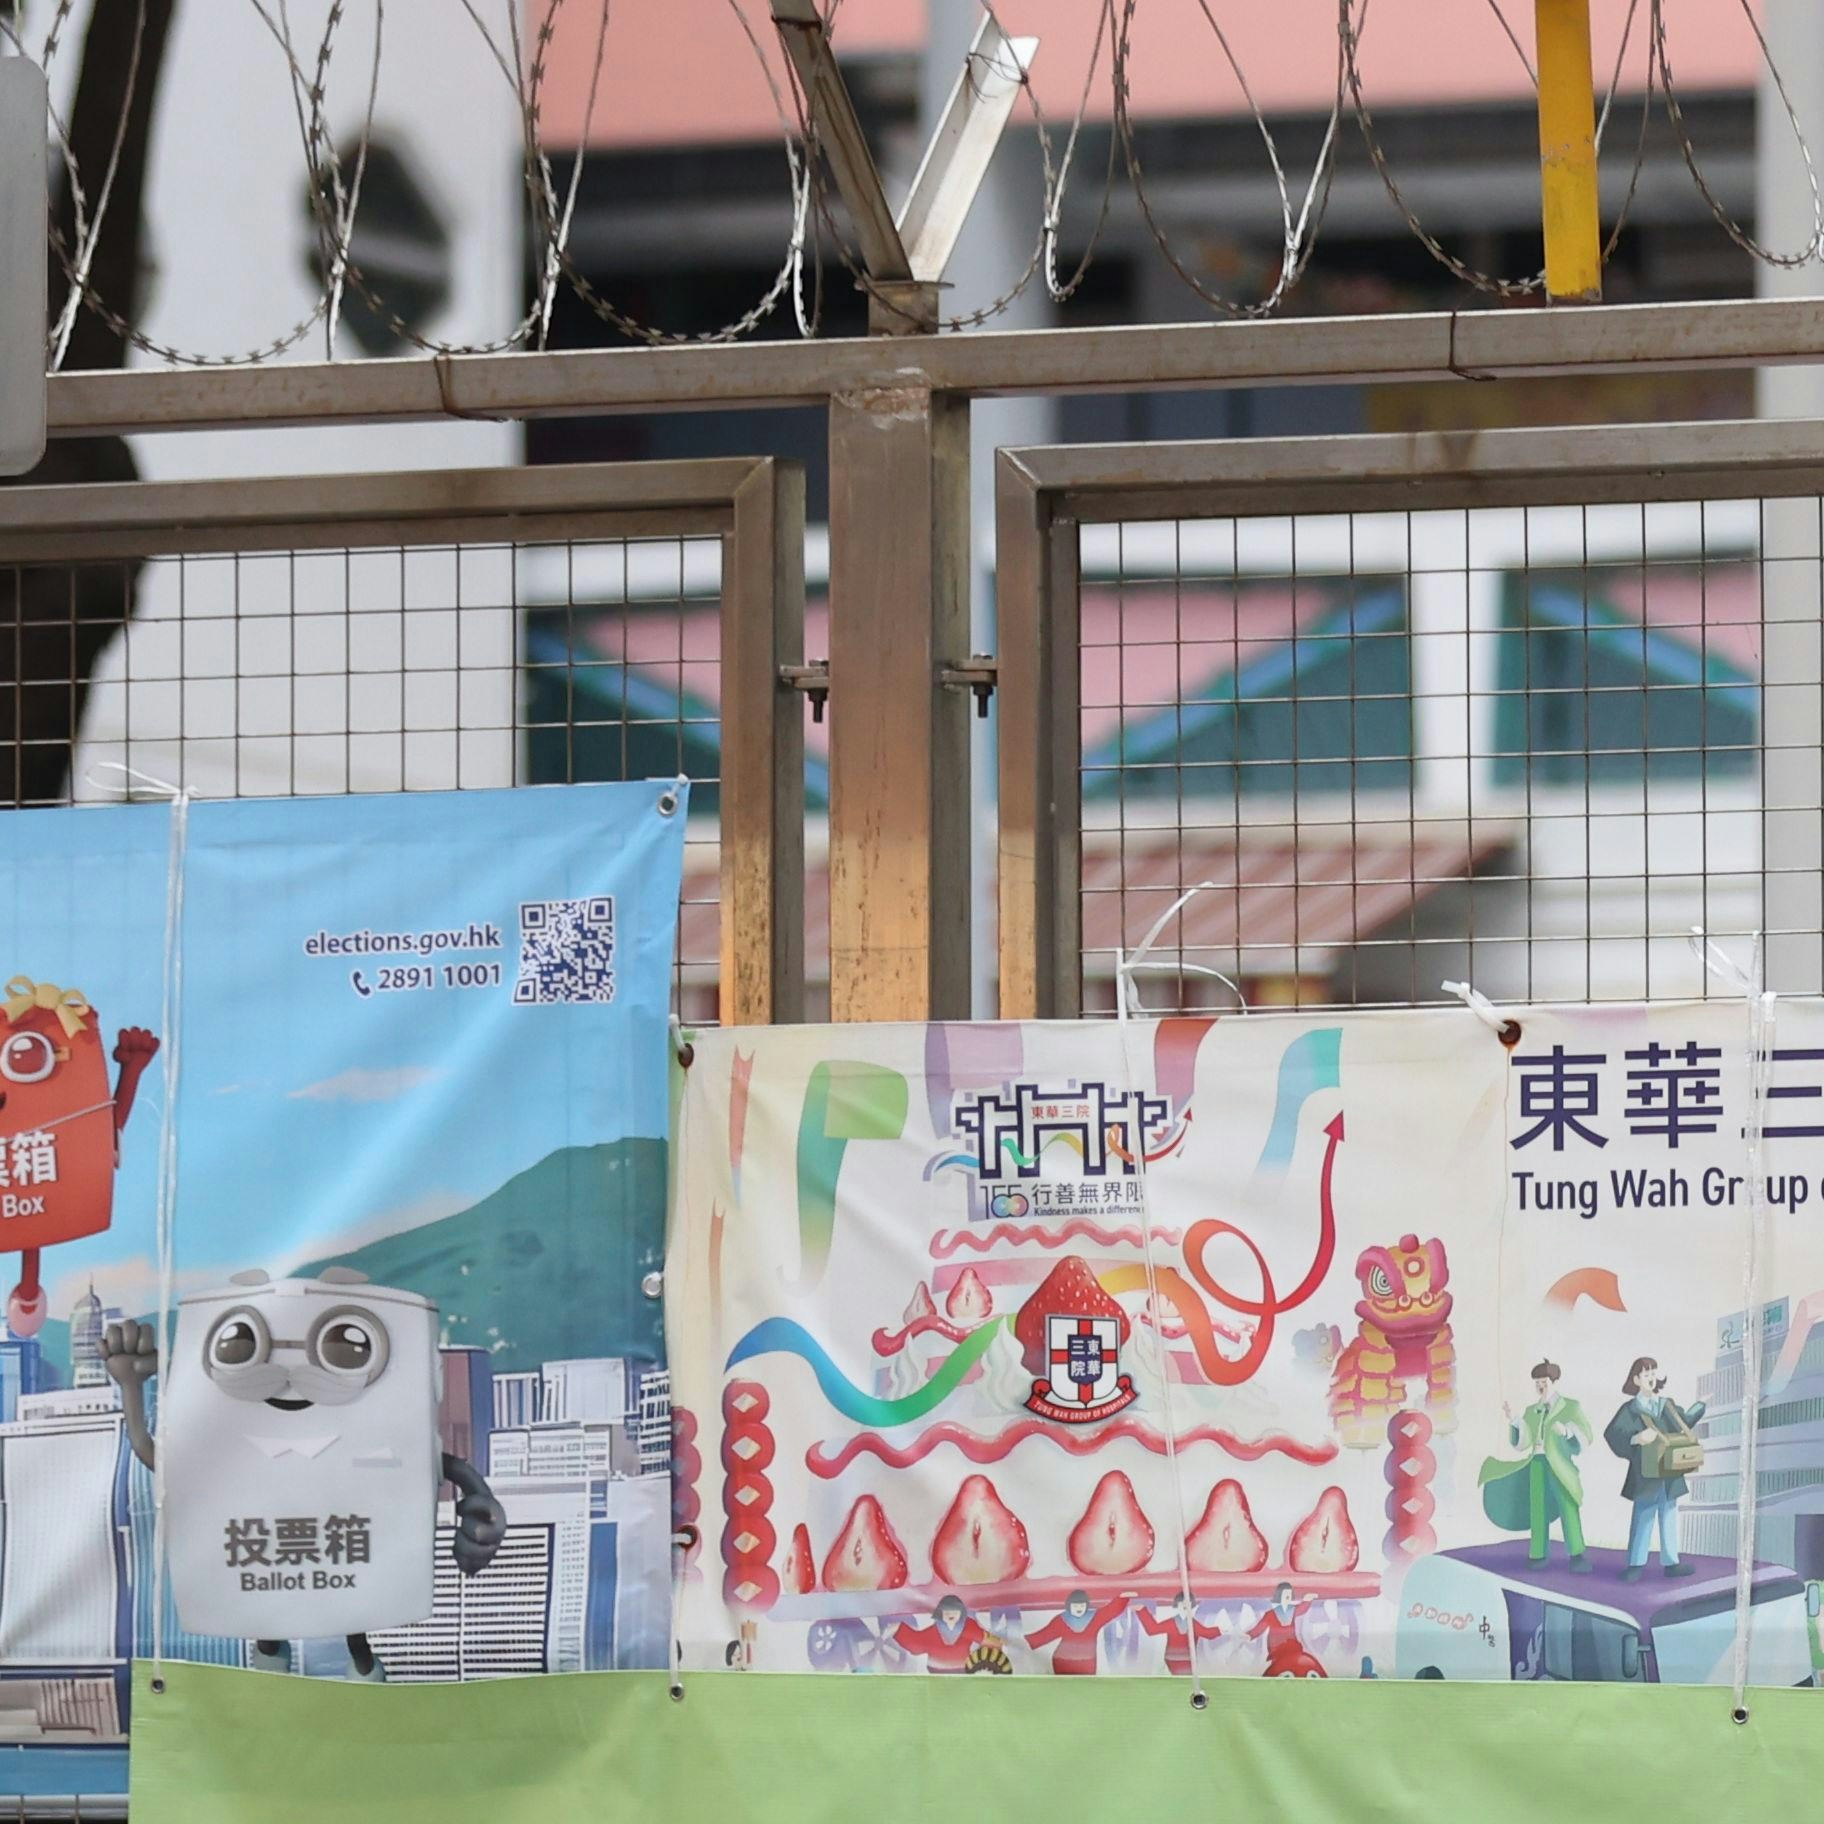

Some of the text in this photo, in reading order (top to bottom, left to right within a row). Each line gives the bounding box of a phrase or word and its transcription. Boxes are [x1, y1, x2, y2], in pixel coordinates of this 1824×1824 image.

[304, 923, 502, 960] elections.gov.hk
[377, 962, 503, 993] 2891 1001
[1031, 1104, 1091, 1121] 東華三院
[1512, 1171, 1600, 1218] Tung
[1610, 1169, 1690, 1210] Wah
[1702, 1166, 1809, 1214] Grup
[0, 1193, 46, 1223] Box
[1033, 1205, 1073, 1217] Kindness
[1072, 1204, 1099, 1215] makes
[1099, 1205, 1106, 1214] a
[224, 1513, 372, 1568] 投票箱
[240, 1567, 356, 1593] Ballot Box
